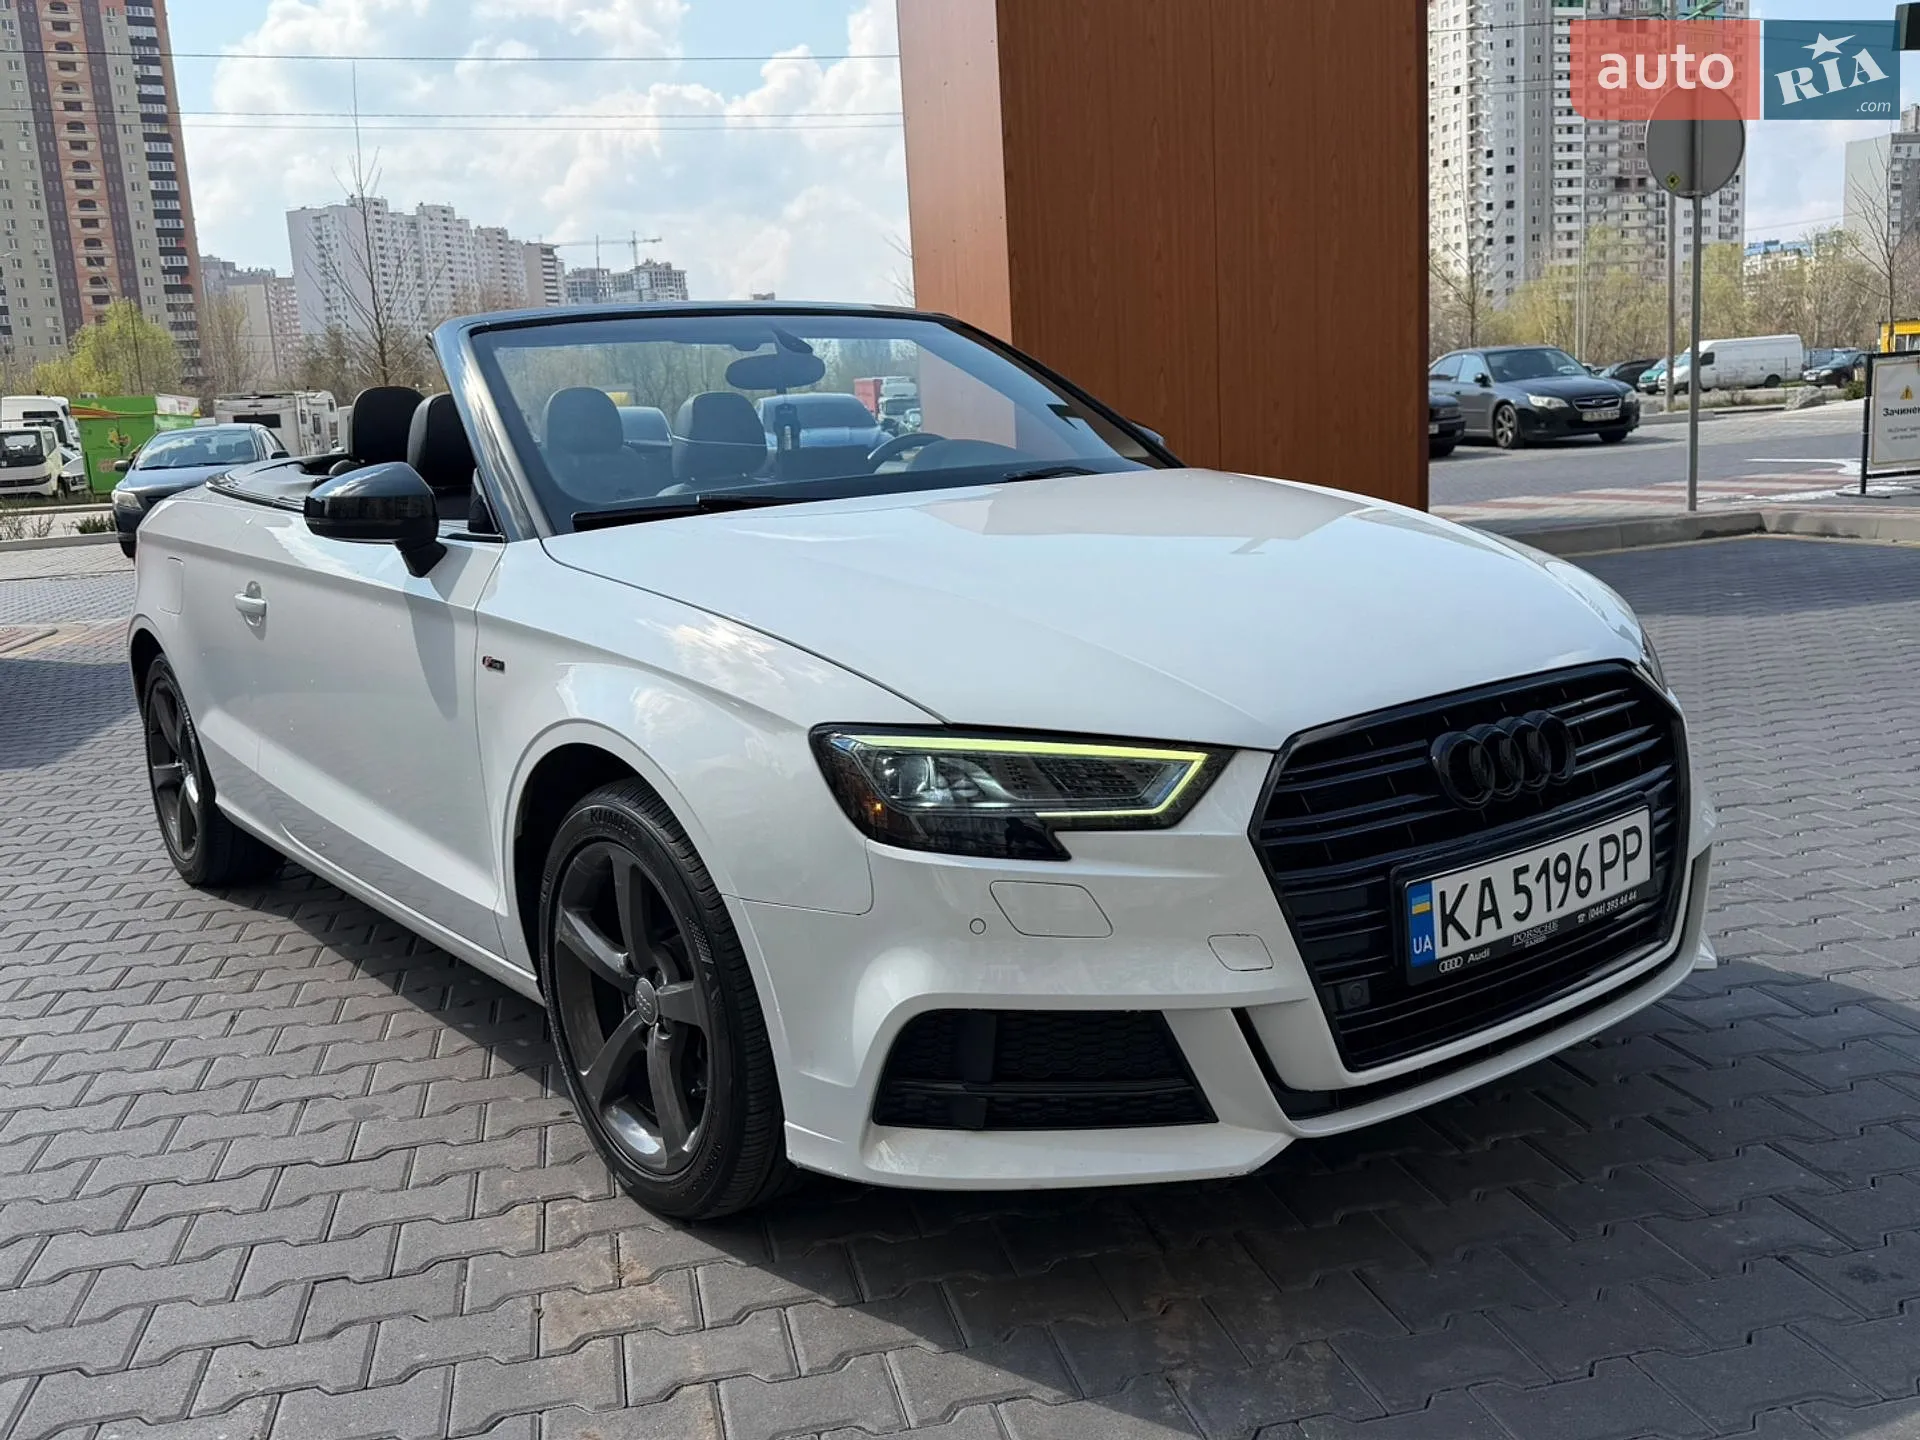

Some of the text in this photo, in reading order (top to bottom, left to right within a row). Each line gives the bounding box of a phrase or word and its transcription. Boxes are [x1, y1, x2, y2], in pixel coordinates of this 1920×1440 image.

[1439, 825, 1643, 947] KA 5196 PP
[1413, 934, 1433, 954] UA
[1467, 947, 1491, 963] Audi
